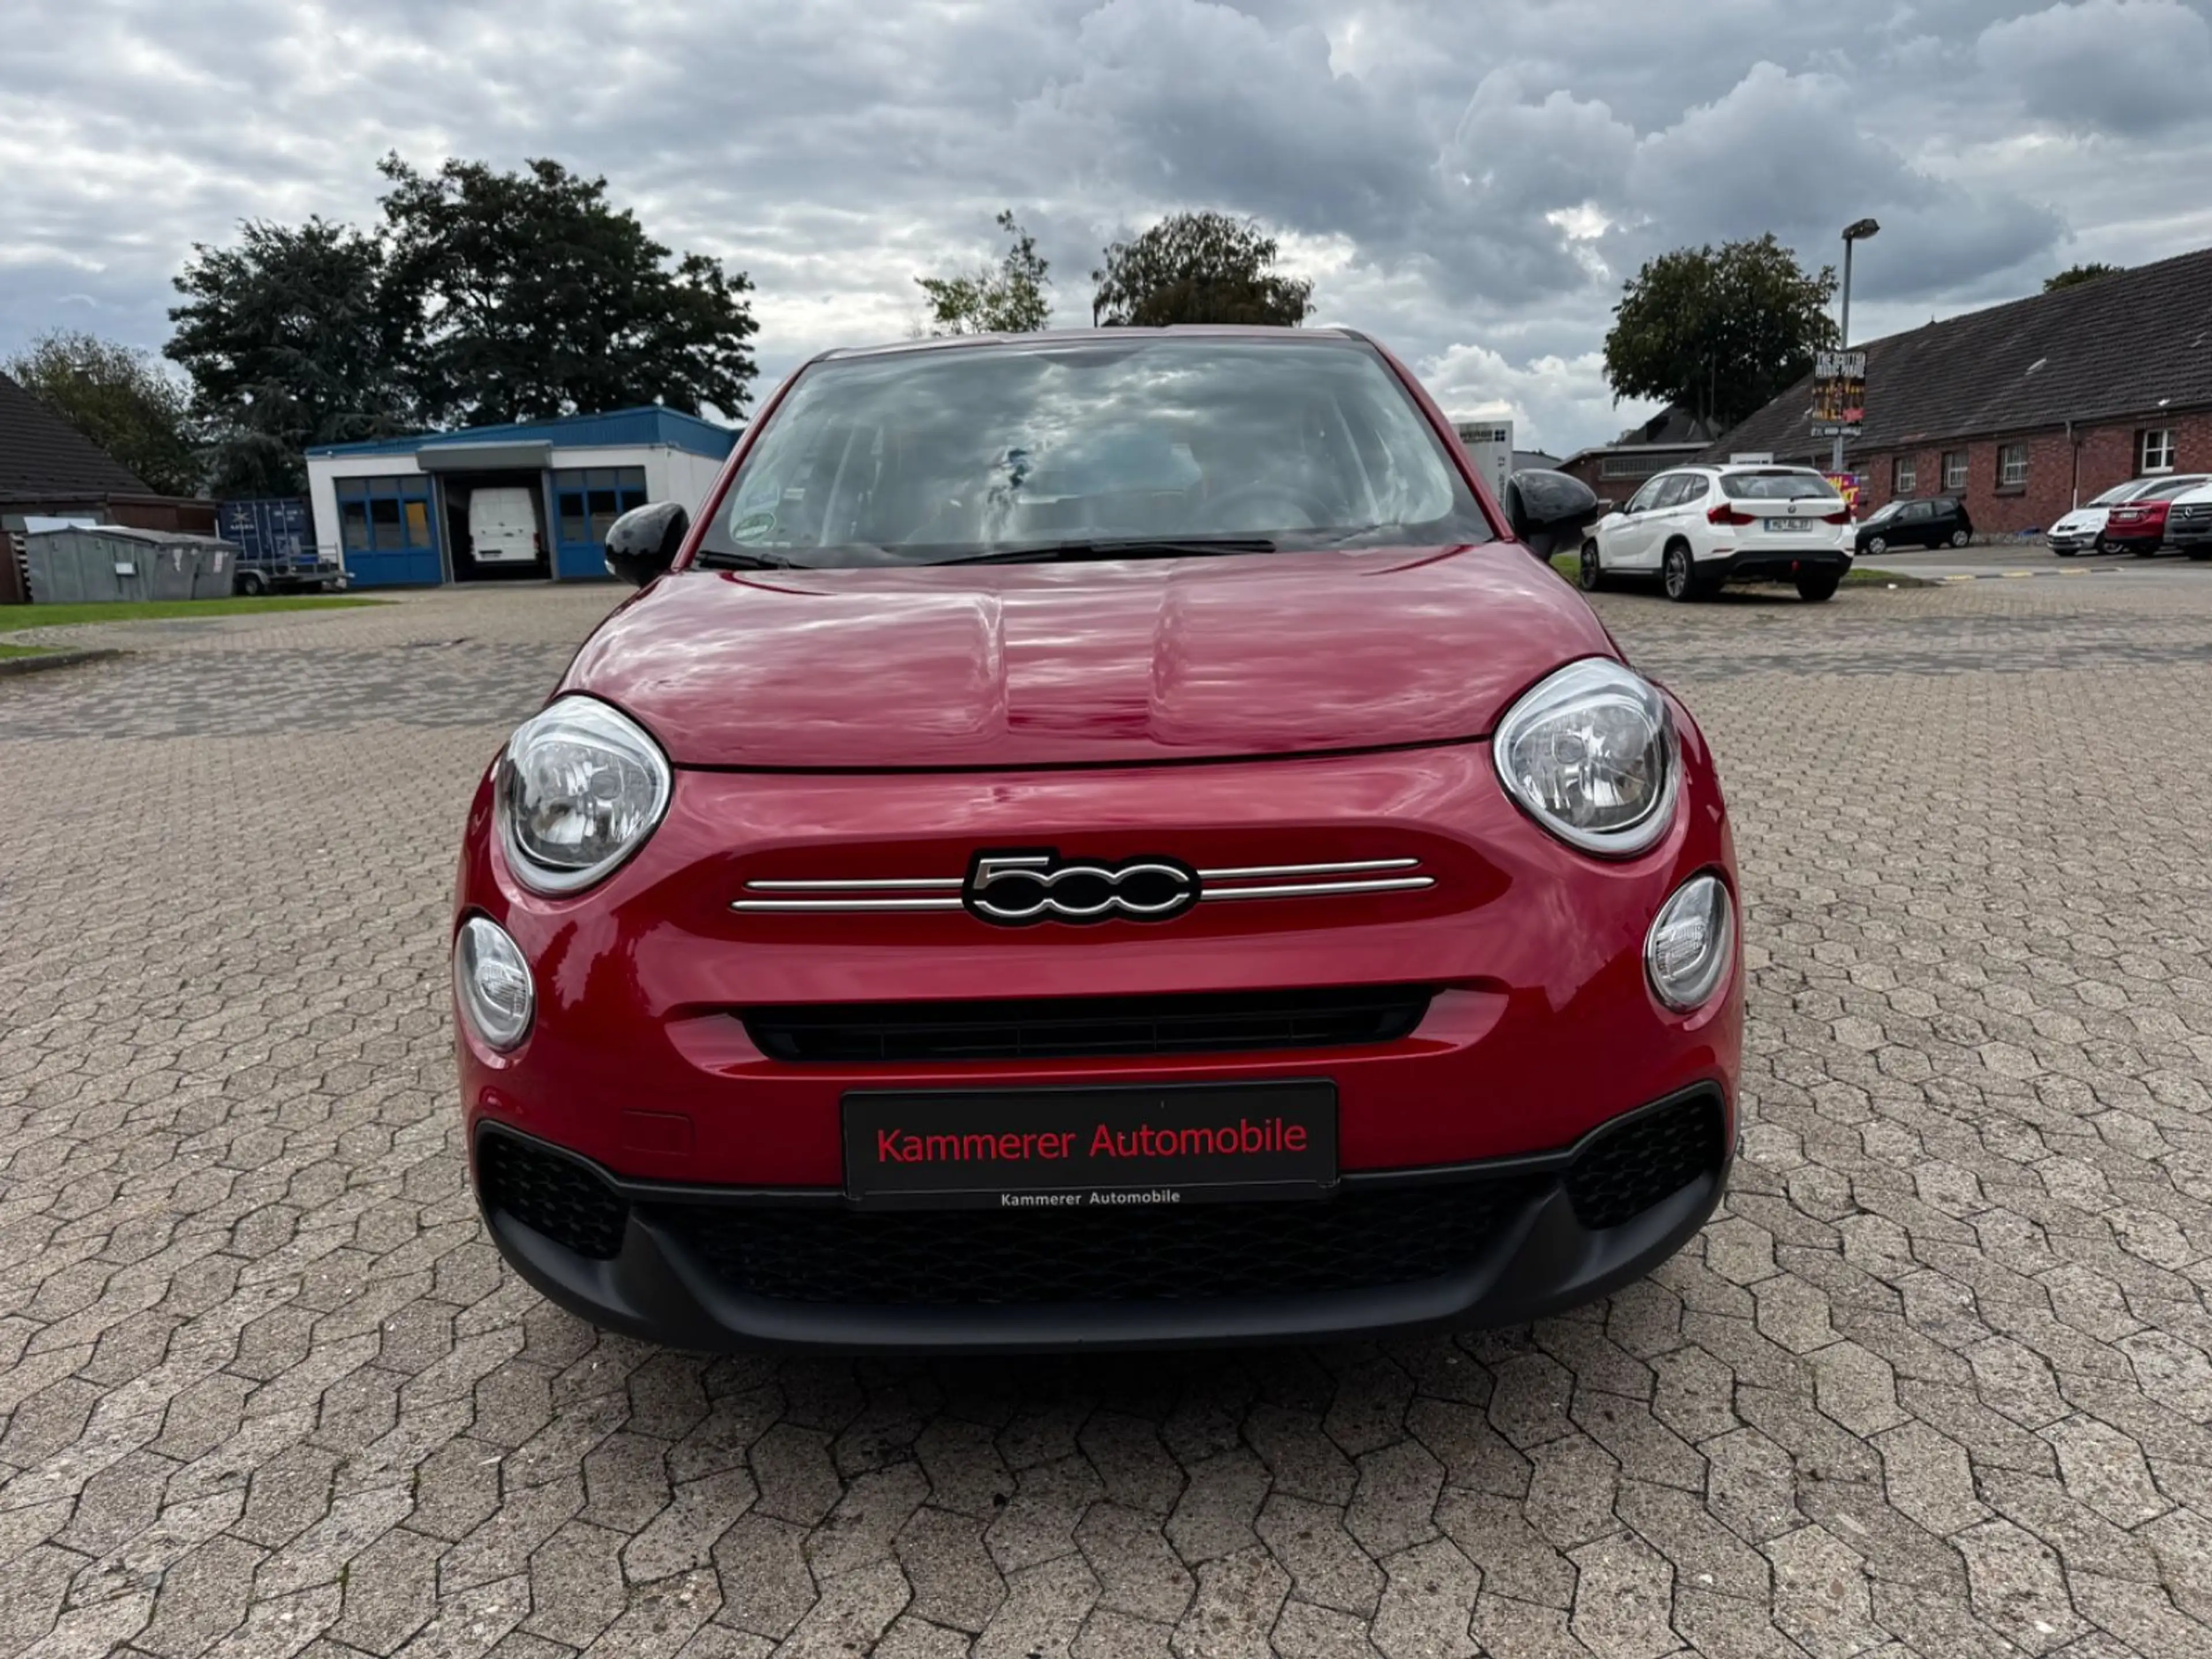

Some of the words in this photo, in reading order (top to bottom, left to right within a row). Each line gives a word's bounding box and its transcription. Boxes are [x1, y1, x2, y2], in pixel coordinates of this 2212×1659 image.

[972, 855, 1191, 918] 500
[877, 1128, 1076, 1163] Kammerer
[1089, 1118, 1308, 1158] Automobile
[1001, 1194, 1082, 1207] Kammerer
[1089, 1190, 1181, 1205] Automobile
